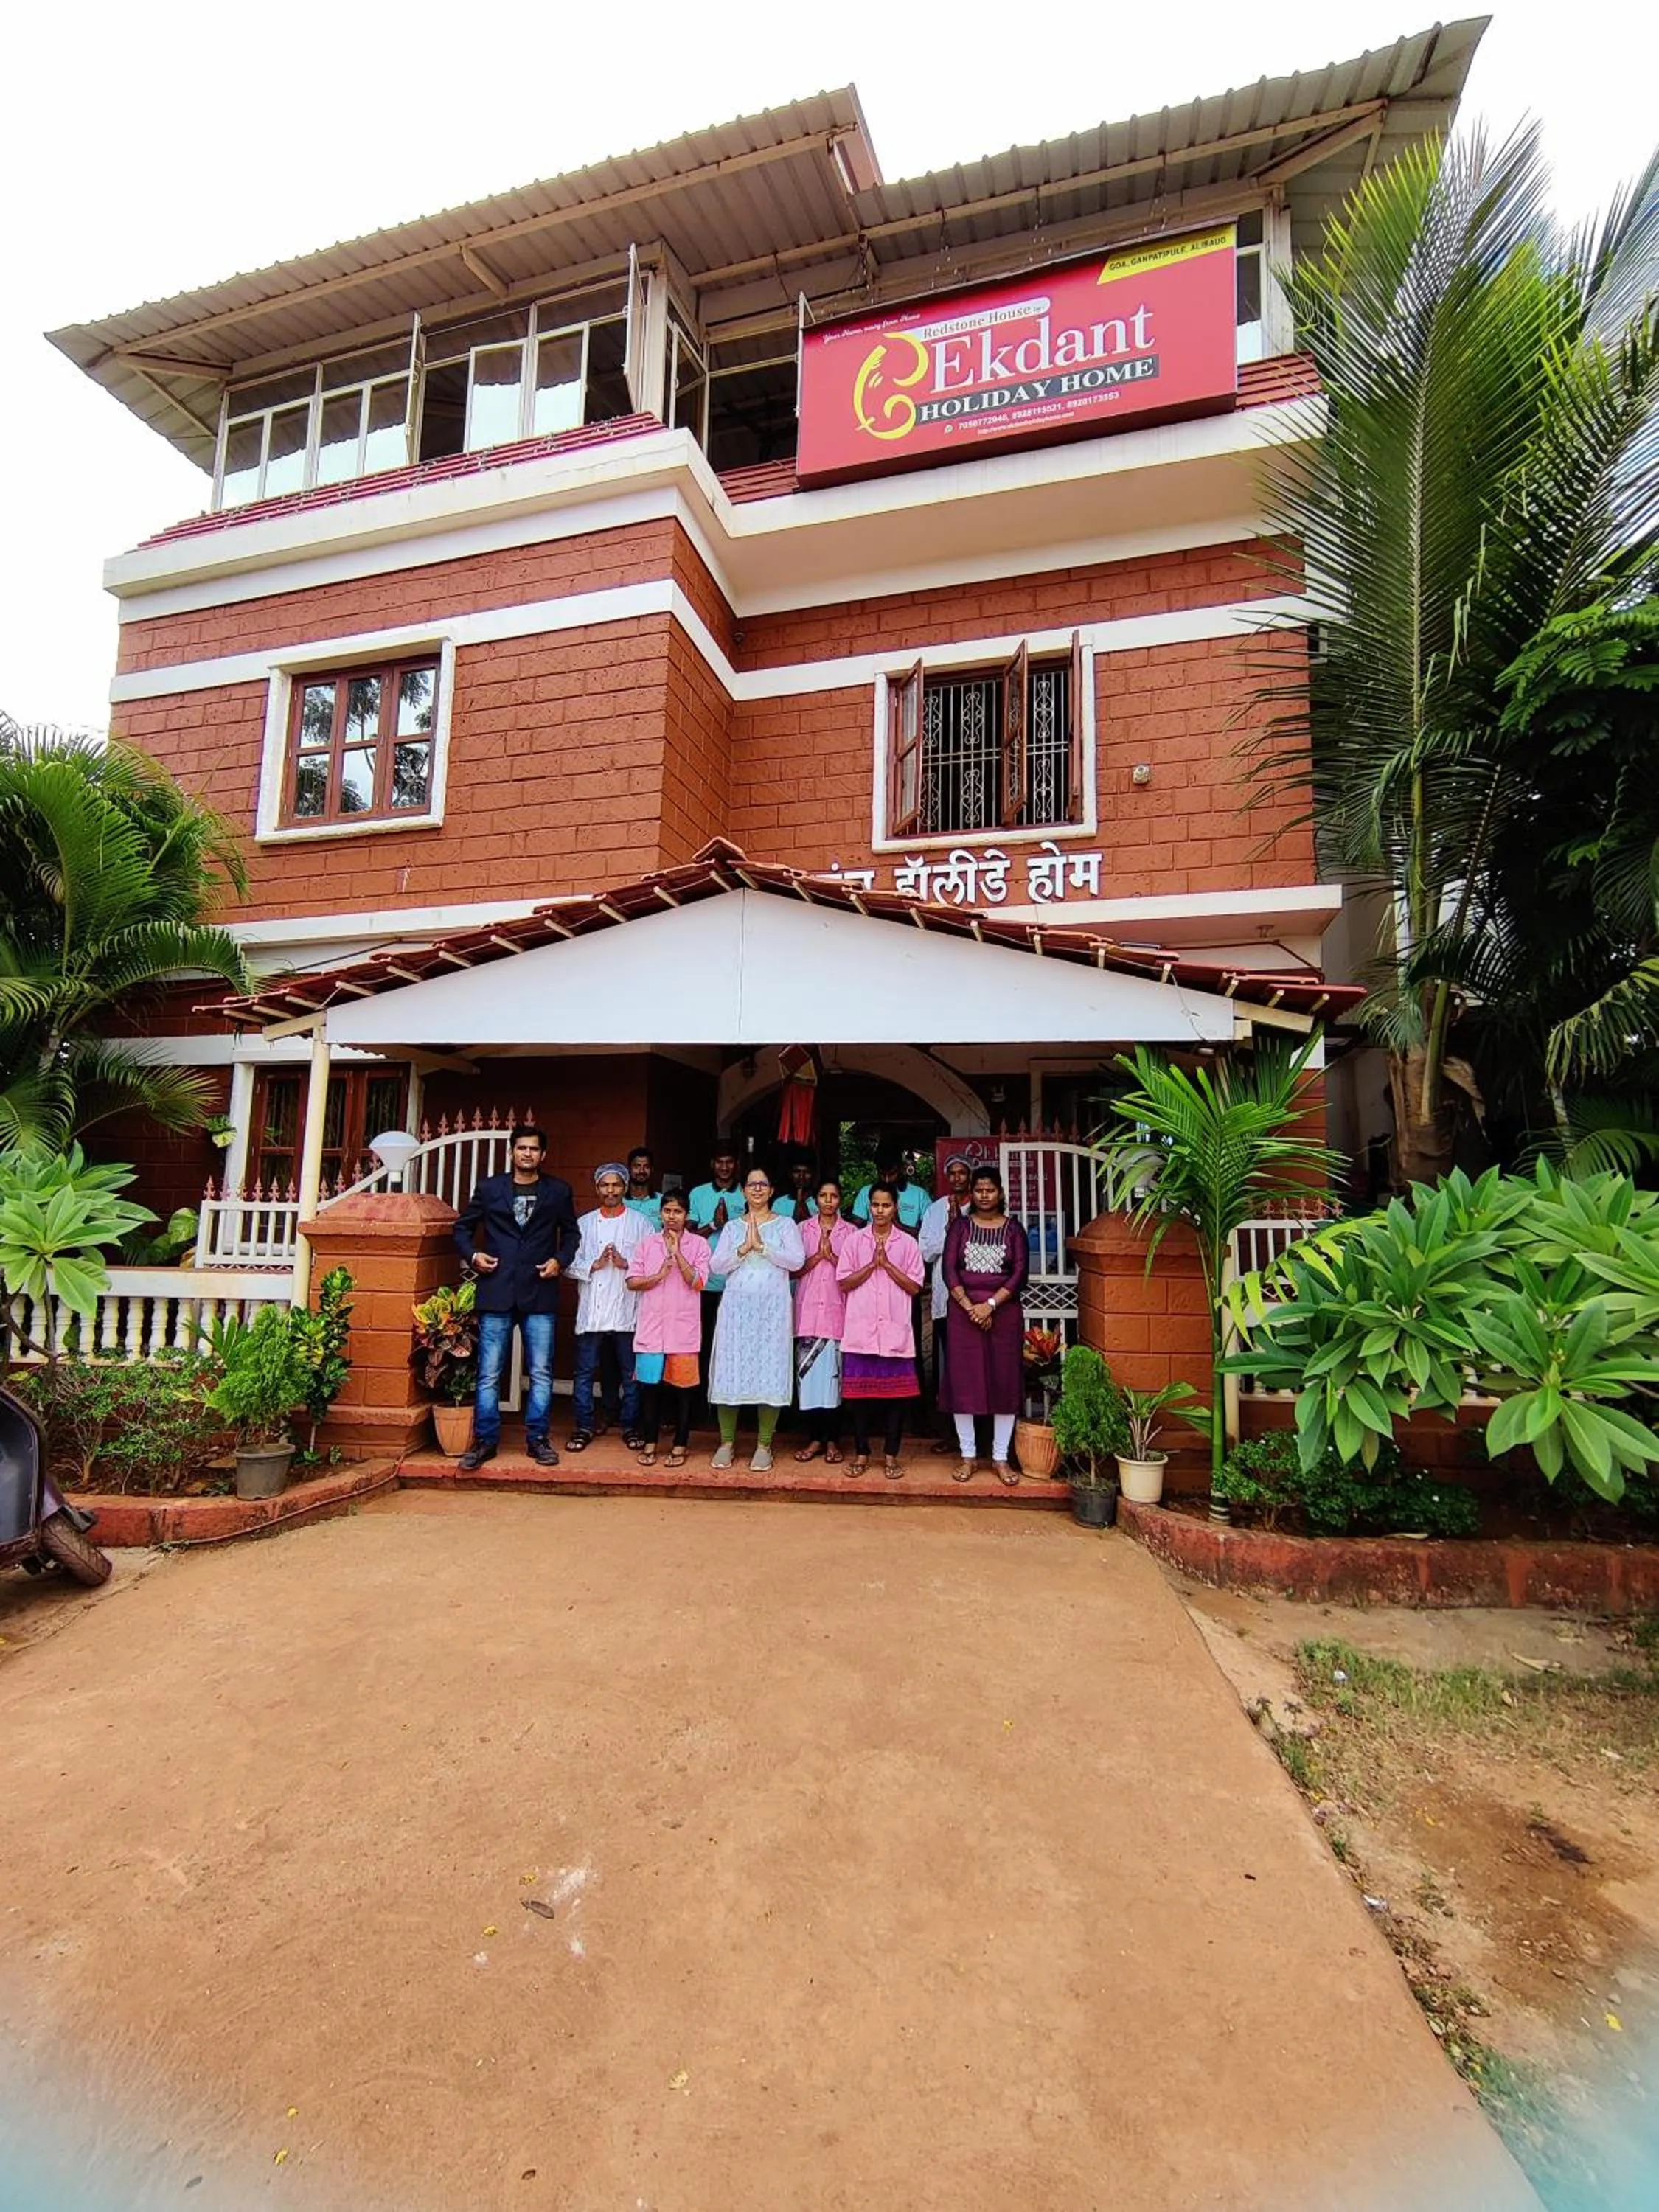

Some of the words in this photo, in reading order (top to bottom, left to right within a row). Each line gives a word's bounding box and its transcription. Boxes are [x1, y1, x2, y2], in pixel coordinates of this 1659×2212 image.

[923, 317, 985, 339] Redstone
[989, 305, 1032, 324] House
[930, 304, 1155, 394] Ekdant
[919, 380, 1051, 422] HOLIDAY
[1060, 358, 1154, 394] HOME
[894, 849, 1011, 905] हॉलीडे
[1026, 840, 1103, 904] होम
